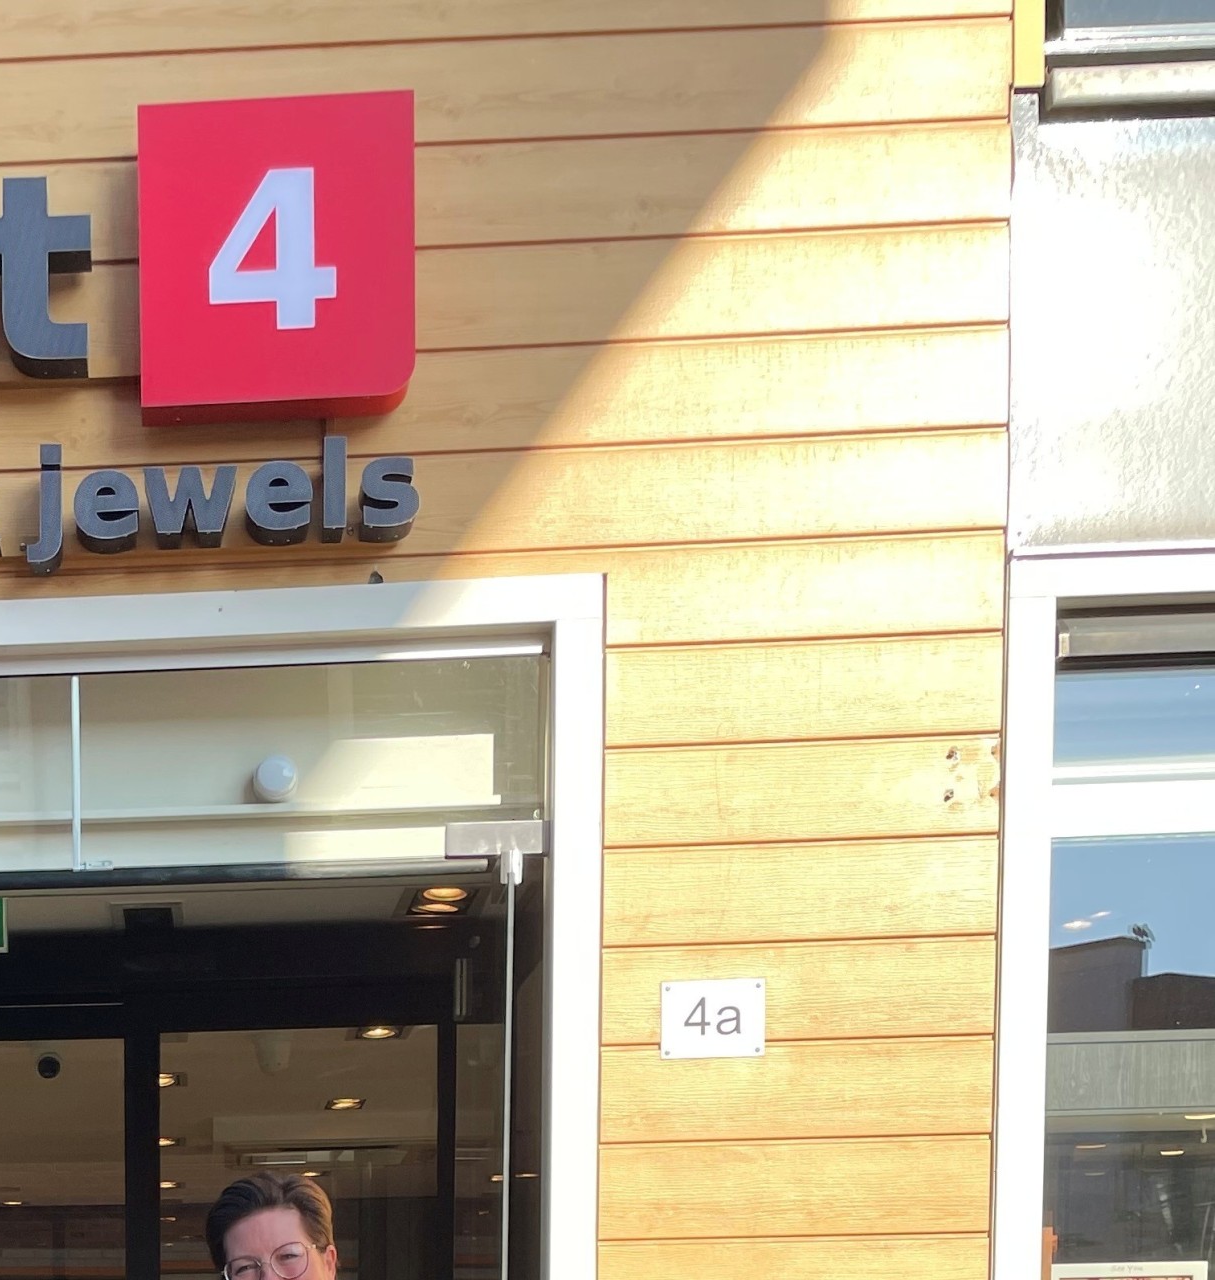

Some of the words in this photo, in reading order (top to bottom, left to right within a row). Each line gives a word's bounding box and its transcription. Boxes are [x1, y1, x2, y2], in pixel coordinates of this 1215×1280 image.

[207, 165, 338, 331] 4
[20, 434, 421, 573] jewels
[683, 996, 742, 1036] 4a
